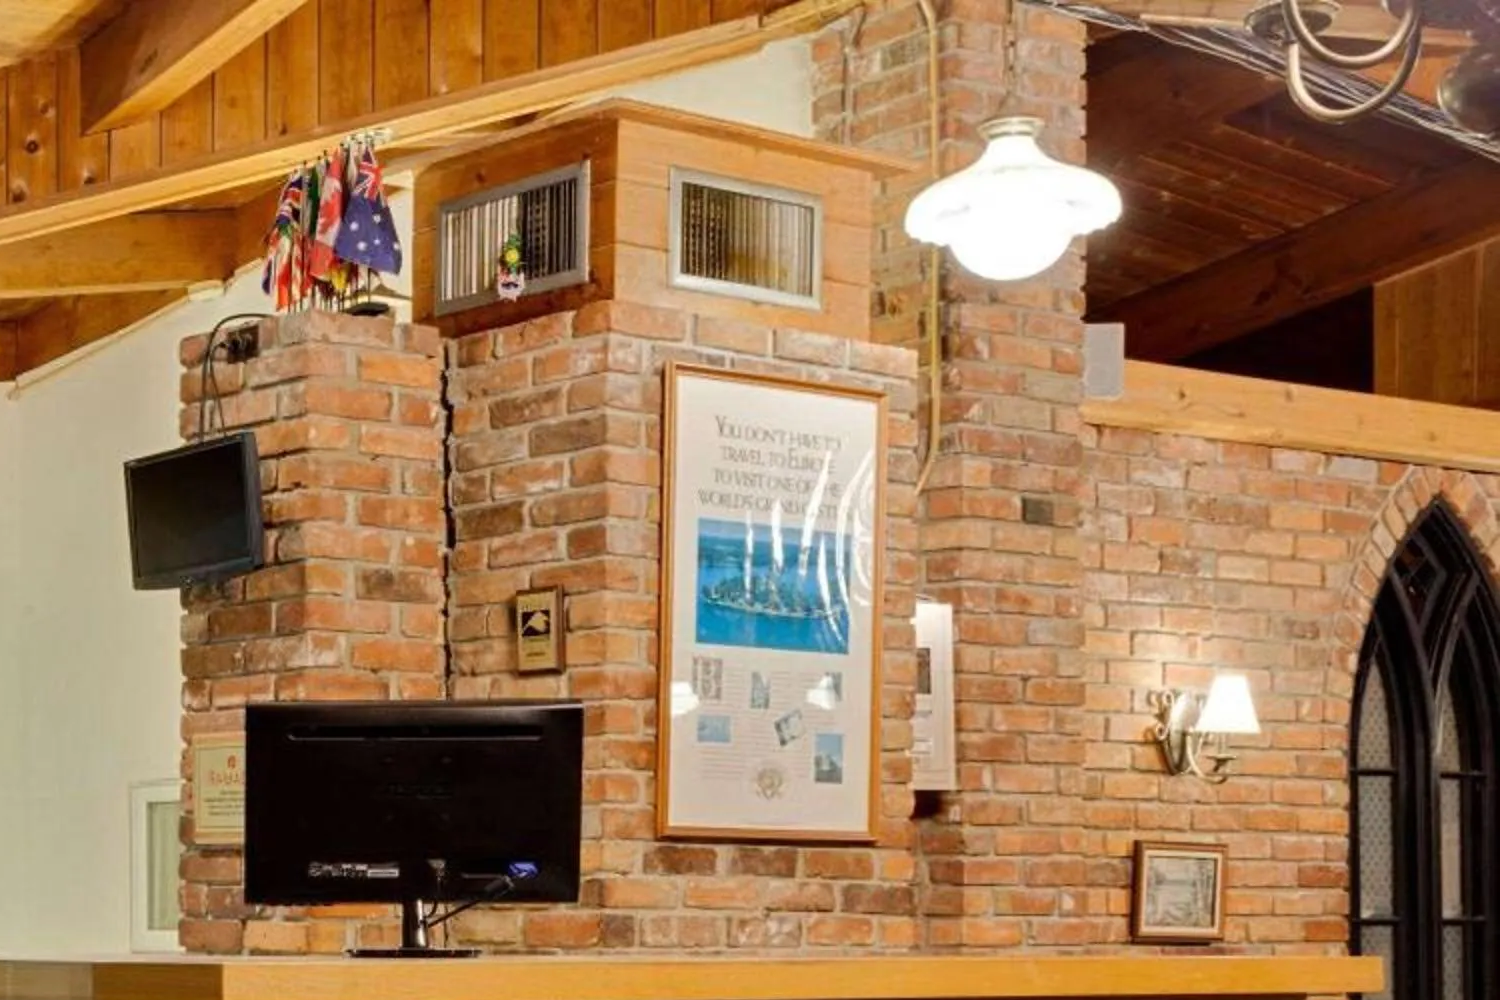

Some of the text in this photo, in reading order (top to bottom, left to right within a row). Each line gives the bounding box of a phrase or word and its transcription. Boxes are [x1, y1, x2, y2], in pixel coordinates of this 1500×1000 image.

[719, 445, 764, 467] TRAVEL
[769, 451, 786, 468] TO
[713, 467, 731, 484] TO
[734, 469, 766, 488] VISIT
[767, 475, 795, 492] ONE
